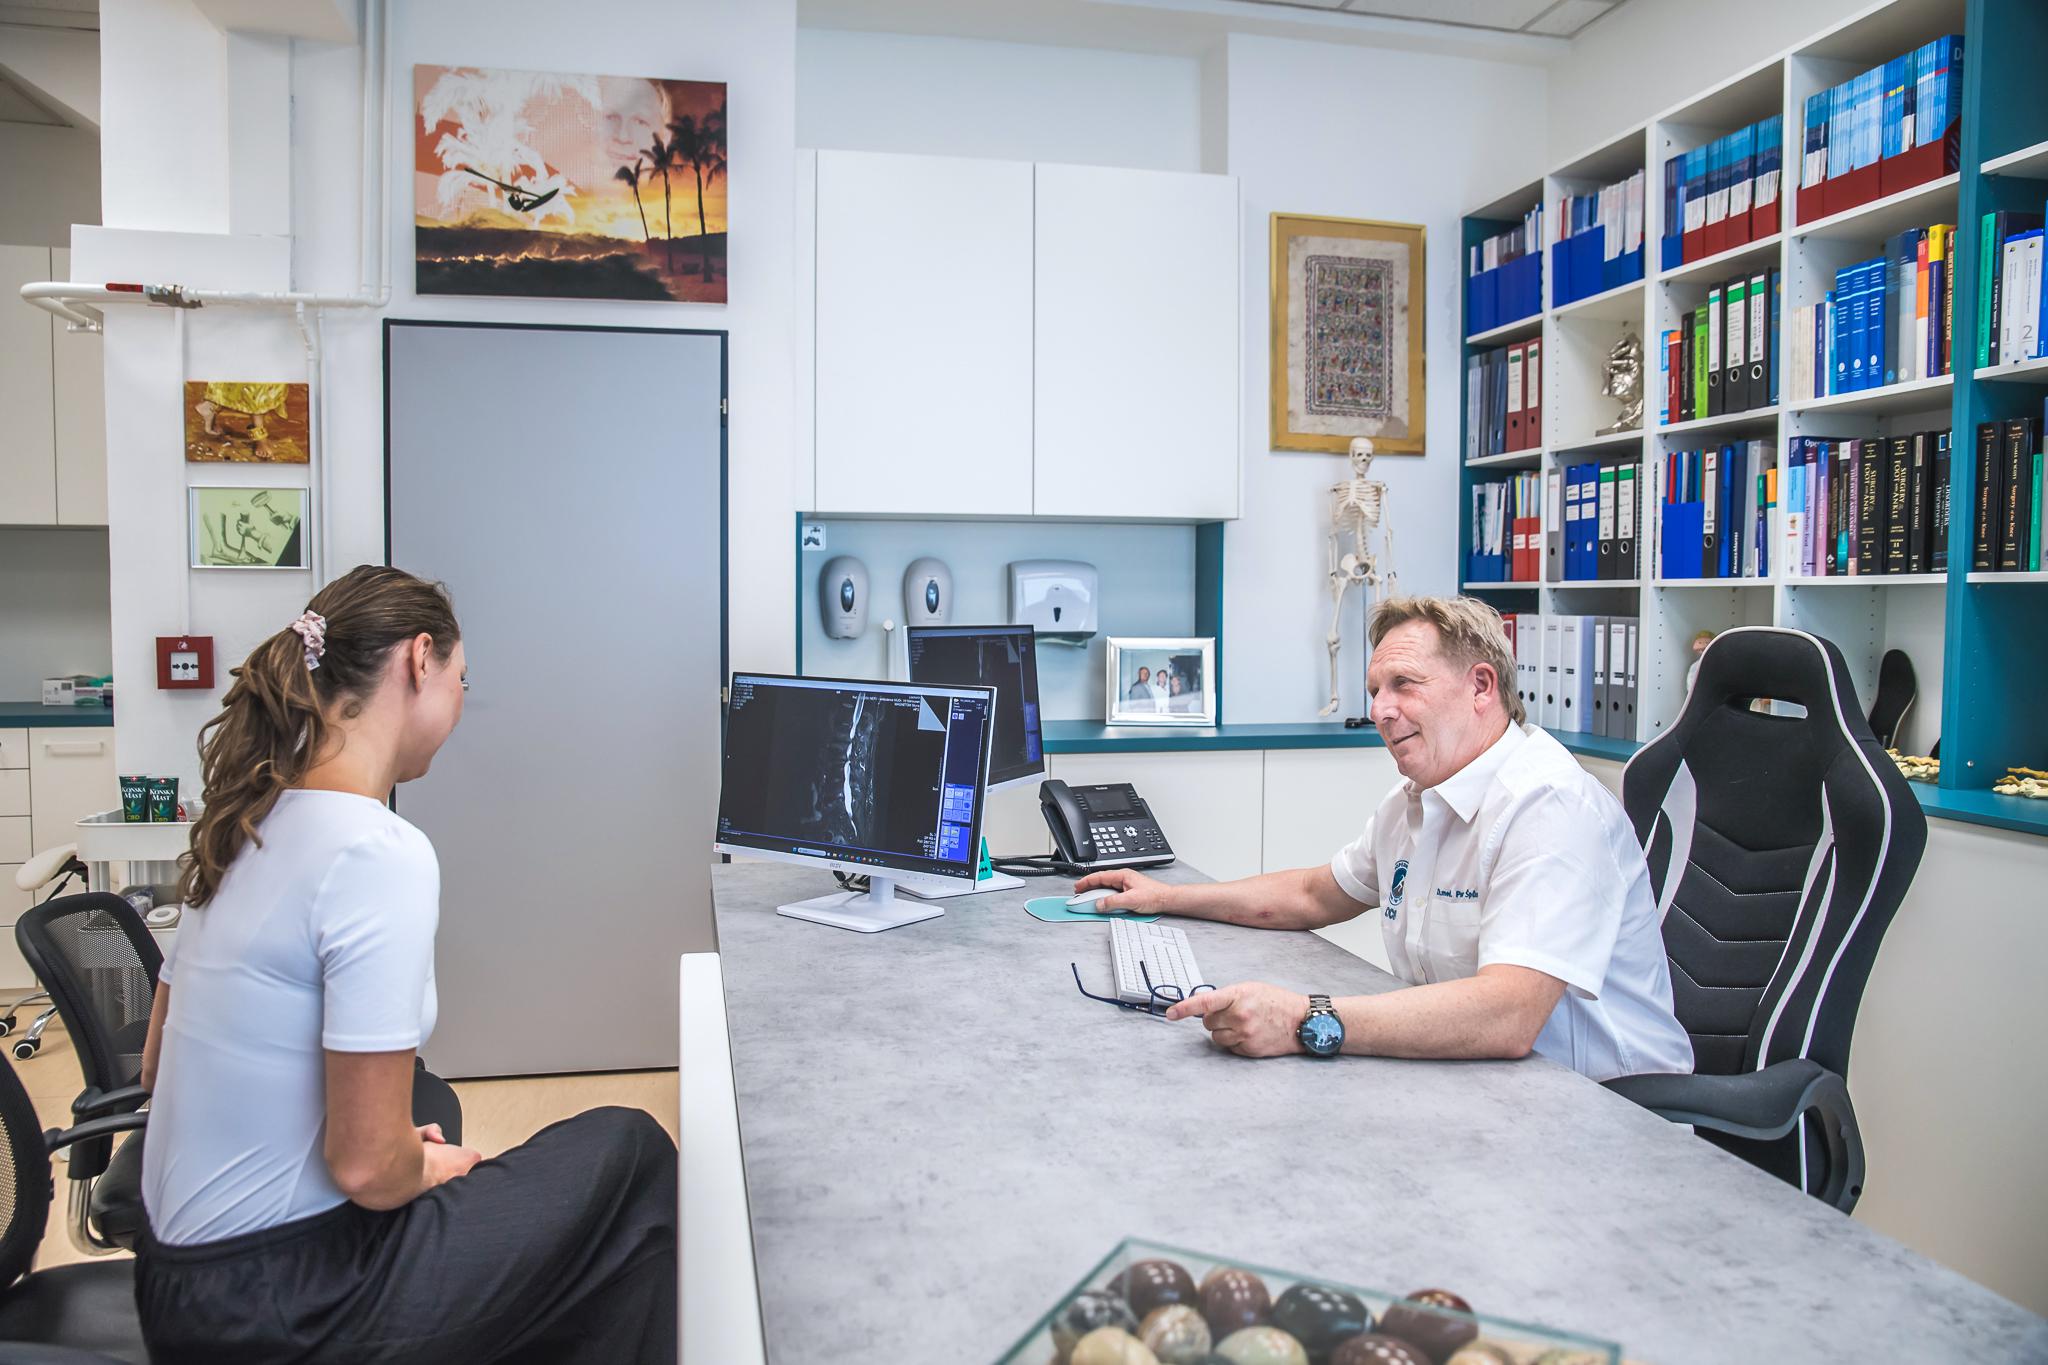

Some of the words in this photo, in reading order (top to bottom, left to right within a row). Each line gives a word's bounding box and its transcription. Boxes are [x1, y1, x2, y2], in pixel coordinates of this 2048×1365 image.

[2022, 325, 2033, 340] 2
[1863, 463, 1872, 484] FOOT
[1893, 460, 1902, 482] FOOT
[1869, 470, 1877, 504] SURGERY
[1898, 467, 1907, 502] SURGERY
[2009, 484, 2017, 508] Surgery
[1862, 494, 1870, 520] ANKLE
[1891, 492, 1899, 519] ANKLE
[1981, 486, 1989, 509] Surgery
[1980, 523, 1988, 538] Knee
[2008, 522, 2016, 537] Knee
